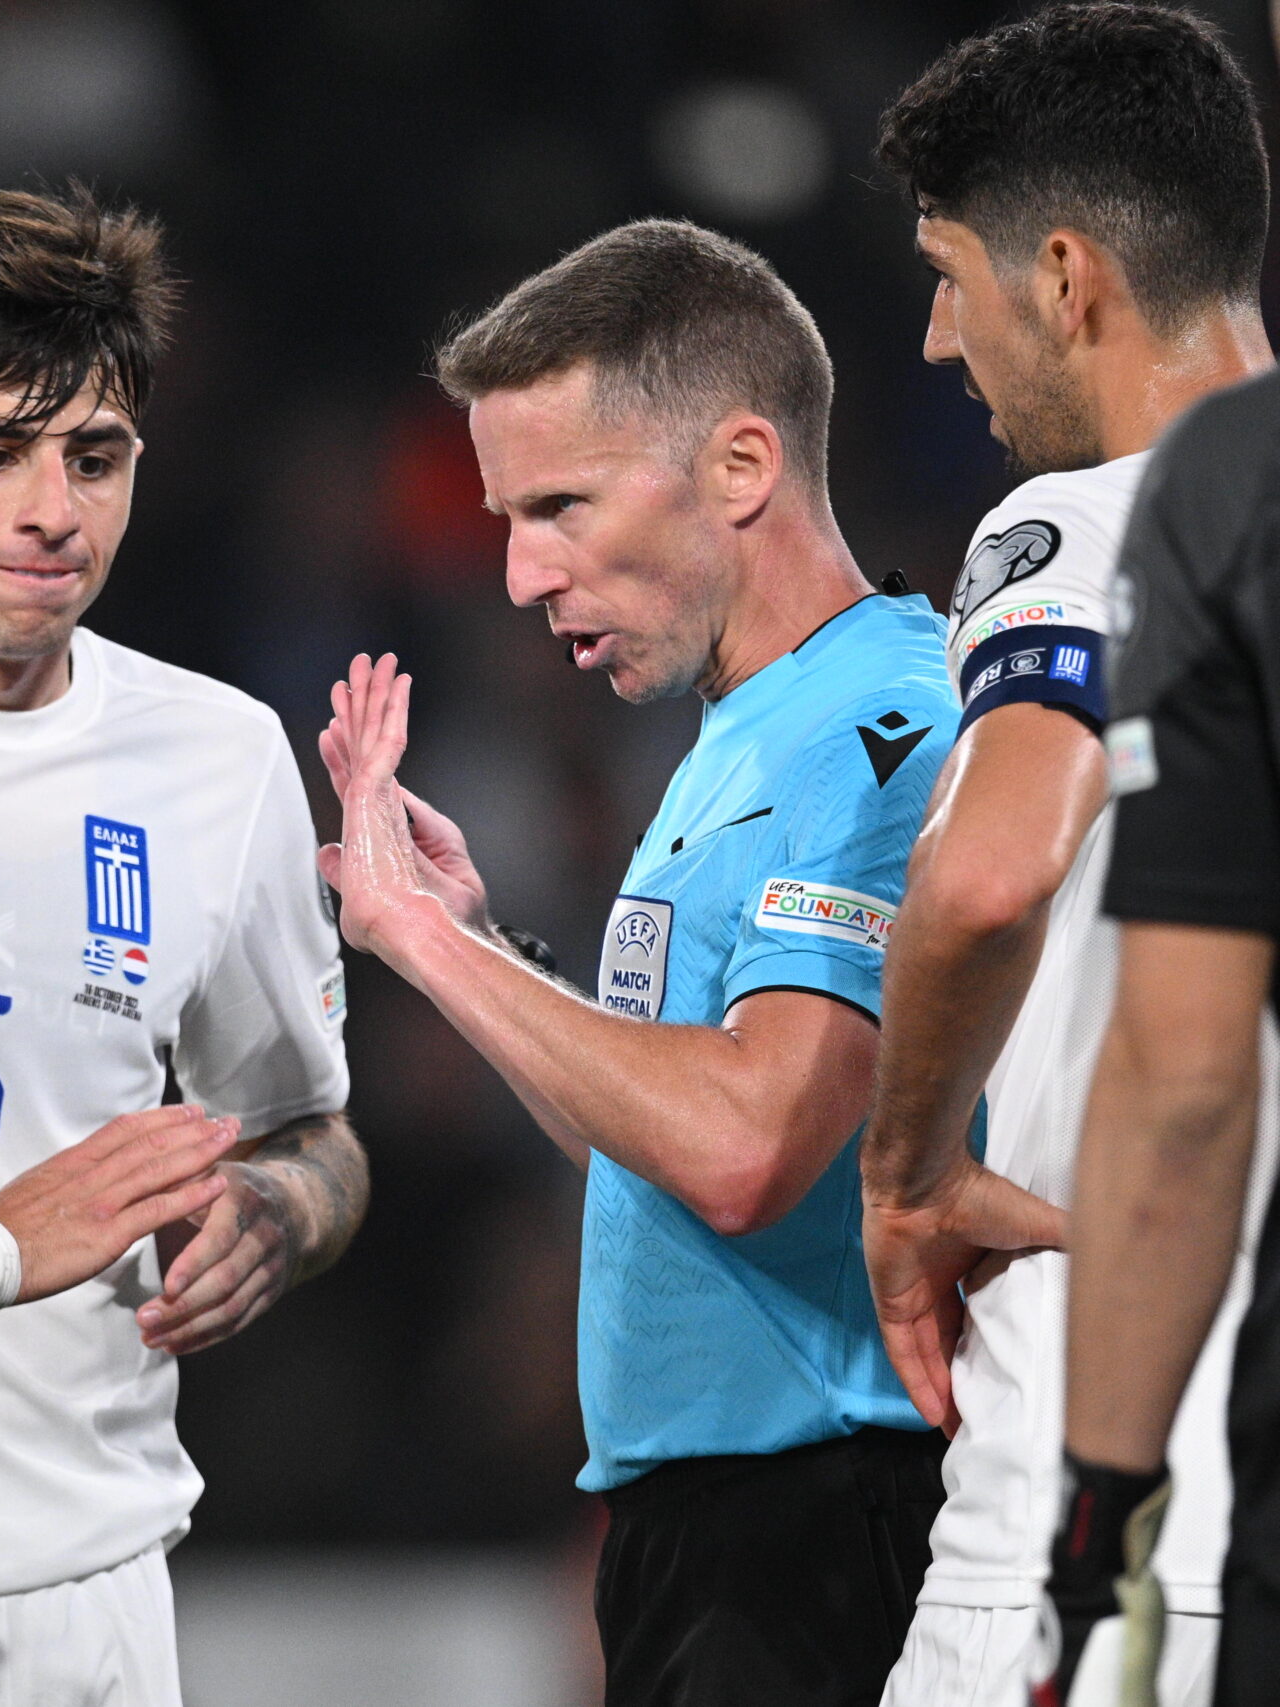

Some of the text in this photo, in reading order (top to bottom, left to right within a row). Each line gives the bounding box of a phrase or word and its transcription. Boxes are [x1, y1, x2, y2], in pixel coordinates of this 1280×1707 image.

[769, 881, 805, 894] UEFA
[617, 918, 656, 952] UEFA
[611, 968, 651, 992] MATCH
[605, 994, 651, 1018] OFFICIAL
